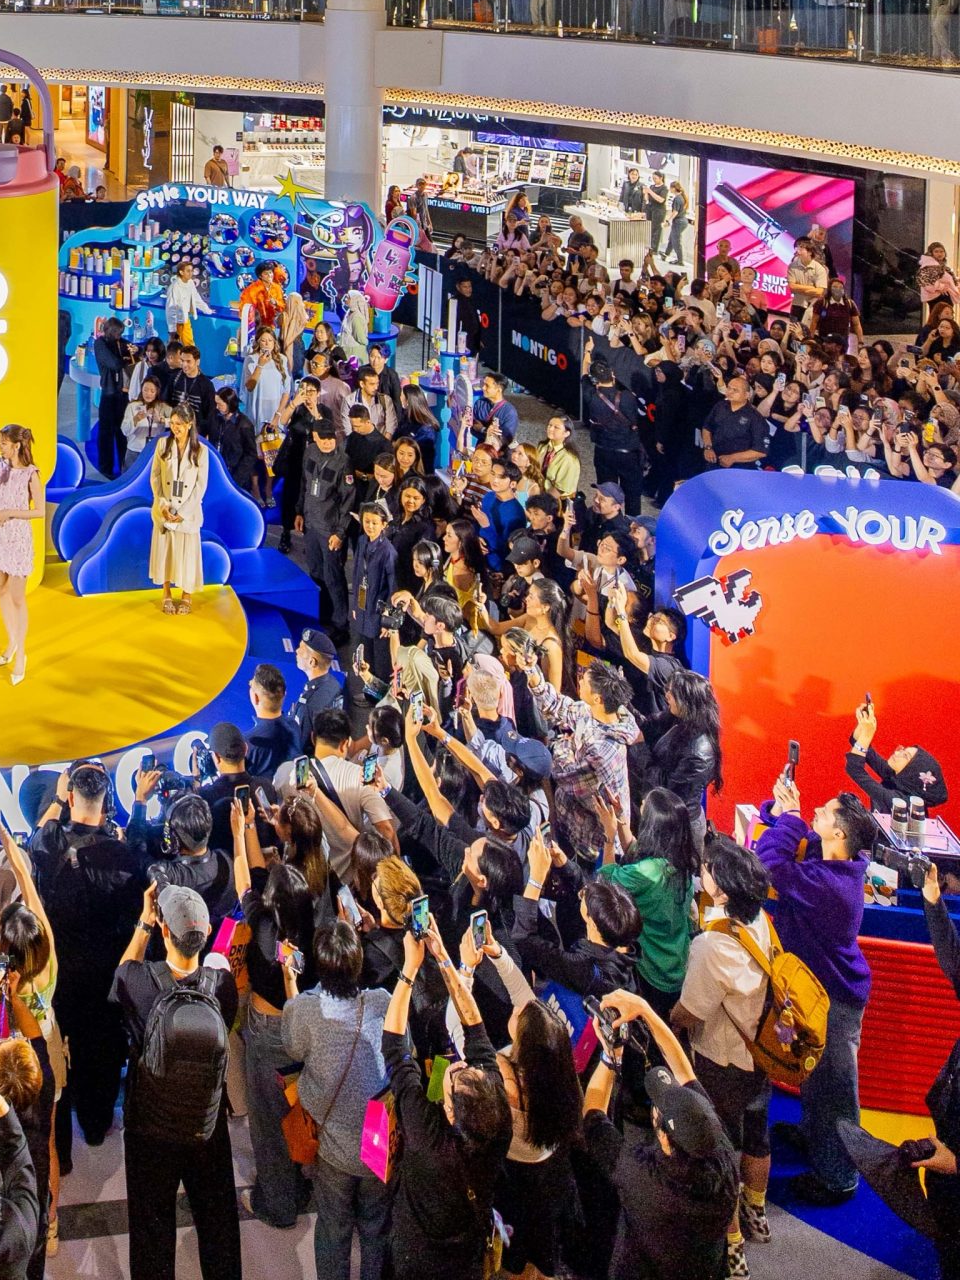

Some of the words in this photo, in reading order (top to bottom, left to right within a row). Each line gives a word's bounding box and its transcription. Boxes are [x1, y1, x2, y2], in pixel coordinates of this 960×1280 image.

[136, 184, 180, 211] Style
[186, 186, 229, 205] YOUR
[231, 189, 269, 209] WAY
[761, 283, 787, 296] SKIN
[511, 329, 568, 370] MONTIGO
[708, 508, 819, 557] Sense
[829, 506, 946, 556] YOUR
